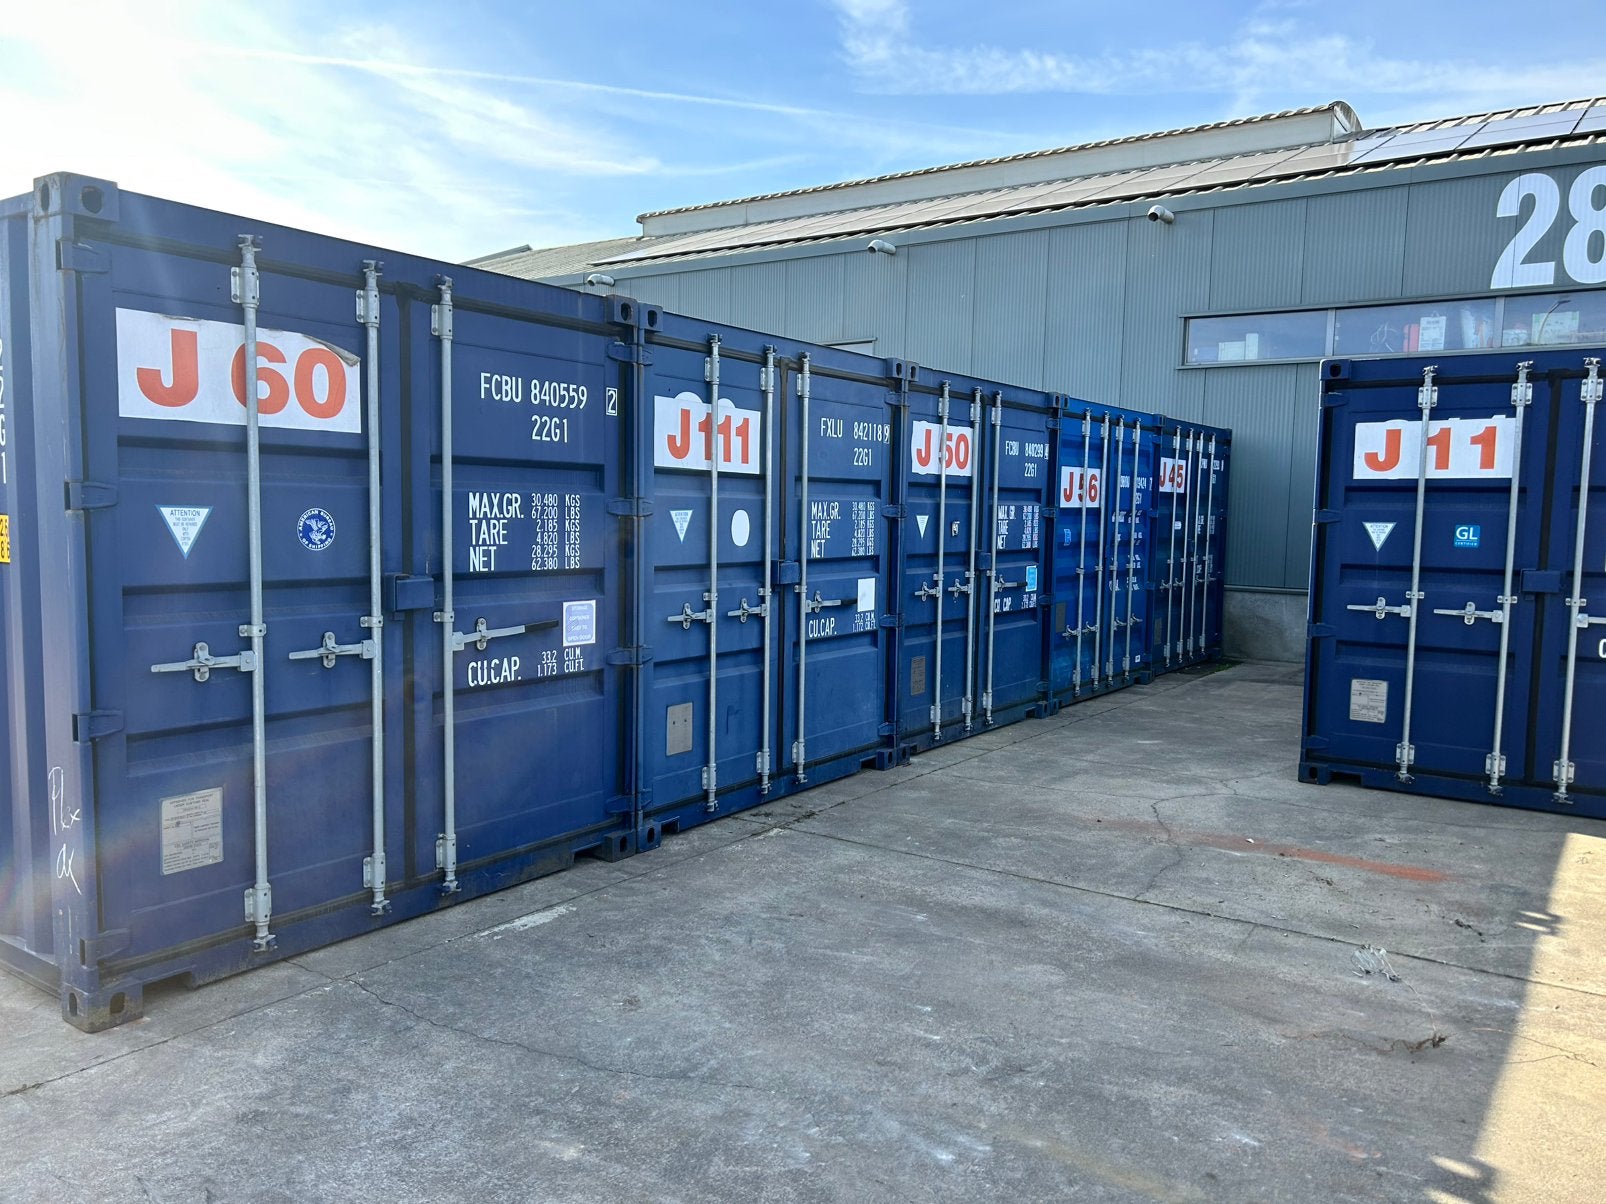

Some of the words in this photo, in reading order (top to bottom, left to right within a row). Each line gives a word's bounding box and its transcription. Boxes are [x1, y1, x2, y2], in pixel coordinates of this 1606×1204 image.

[136, 328, 199, 408] J
[231, 341, 347, 419] 60
[480, 372, 522, 403] FCBU
[530, 379, 588, 410] 840559
[607, 389, 617, 415] 2
[531, 415, 568, 443] 22G1
[820, 417, 843, 438] FXLU
[853, 421, 882, 442] 842118
[853, 447, 872, 466] 22G1
[1005, 440, 1019, 456] FCBU
[1024, 462, 1037, 478] 22G1
[170, 509, 201, 517] ATTENTION
[468, 492, 524, 519] MAX.GR.
[531, 493, 558, 506] 30.480
[565, 494, 580, 507] KGS
[531, 506, 558, 519] 67.200
[565, 507, 580, 519] LBS
[811, 501, 841, 520] MAX.GR.
[298, 509, 318, 531] AMERICAN
[320, 511, 334, 531] BUREAU
[811, 520, 831, 539] TARE
[469, 519, 508, 545] TARE
[536, 519, 558, 532] 2.185
[565, 519, 580, 532] KGS
[536, 532, 558, 545] 4.820
[565, 532, 580, 544] LBS
[996, 534, 1007, 549] NET
[1455, 526, 1478, 540] GL
[308, 537, 332, 549] SHIPPING
[810, 540, 825, 558] NET
[469, 546, 497, 572] NET
[531, 545, 558, 557] 28.295
[565, 544, 580, 557] KGS
[531, 557, 558, 571] 62.380
[565, 557, 580, 569] LBS
[808, 617, 837, 638] CU.CAP.
[468, 656, 522, 687] CU.CAP.
[541, 650, 557, 664] 33.2
[537, 664, 557, 677] 1.173
